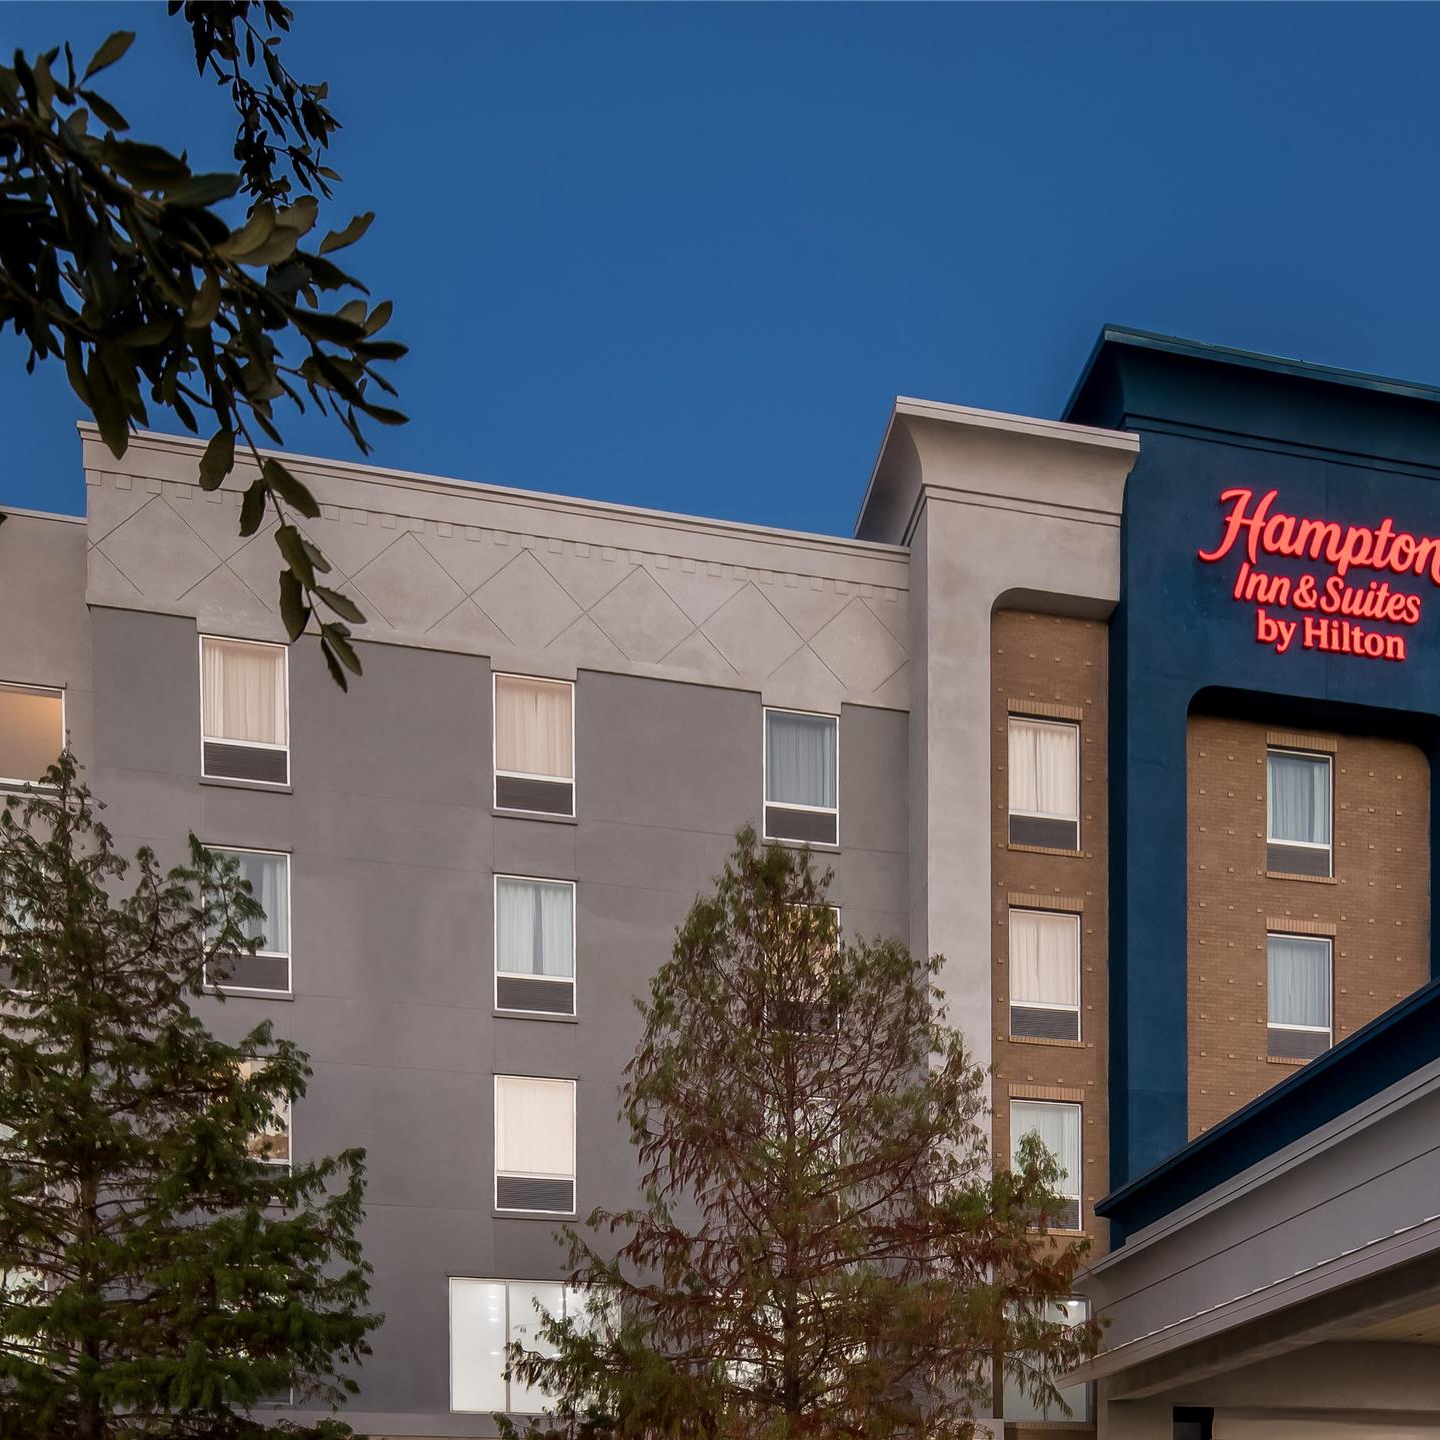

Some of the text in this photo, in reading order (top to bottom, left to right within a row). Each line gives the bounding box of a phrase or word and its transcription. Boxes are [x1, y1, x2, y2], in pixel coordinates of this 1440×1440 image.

[1233, 561, 1291, 607] Inn
[1319, 575, 1422, 625] Suites
[1255, 608, 1406, 662] by Hilton
